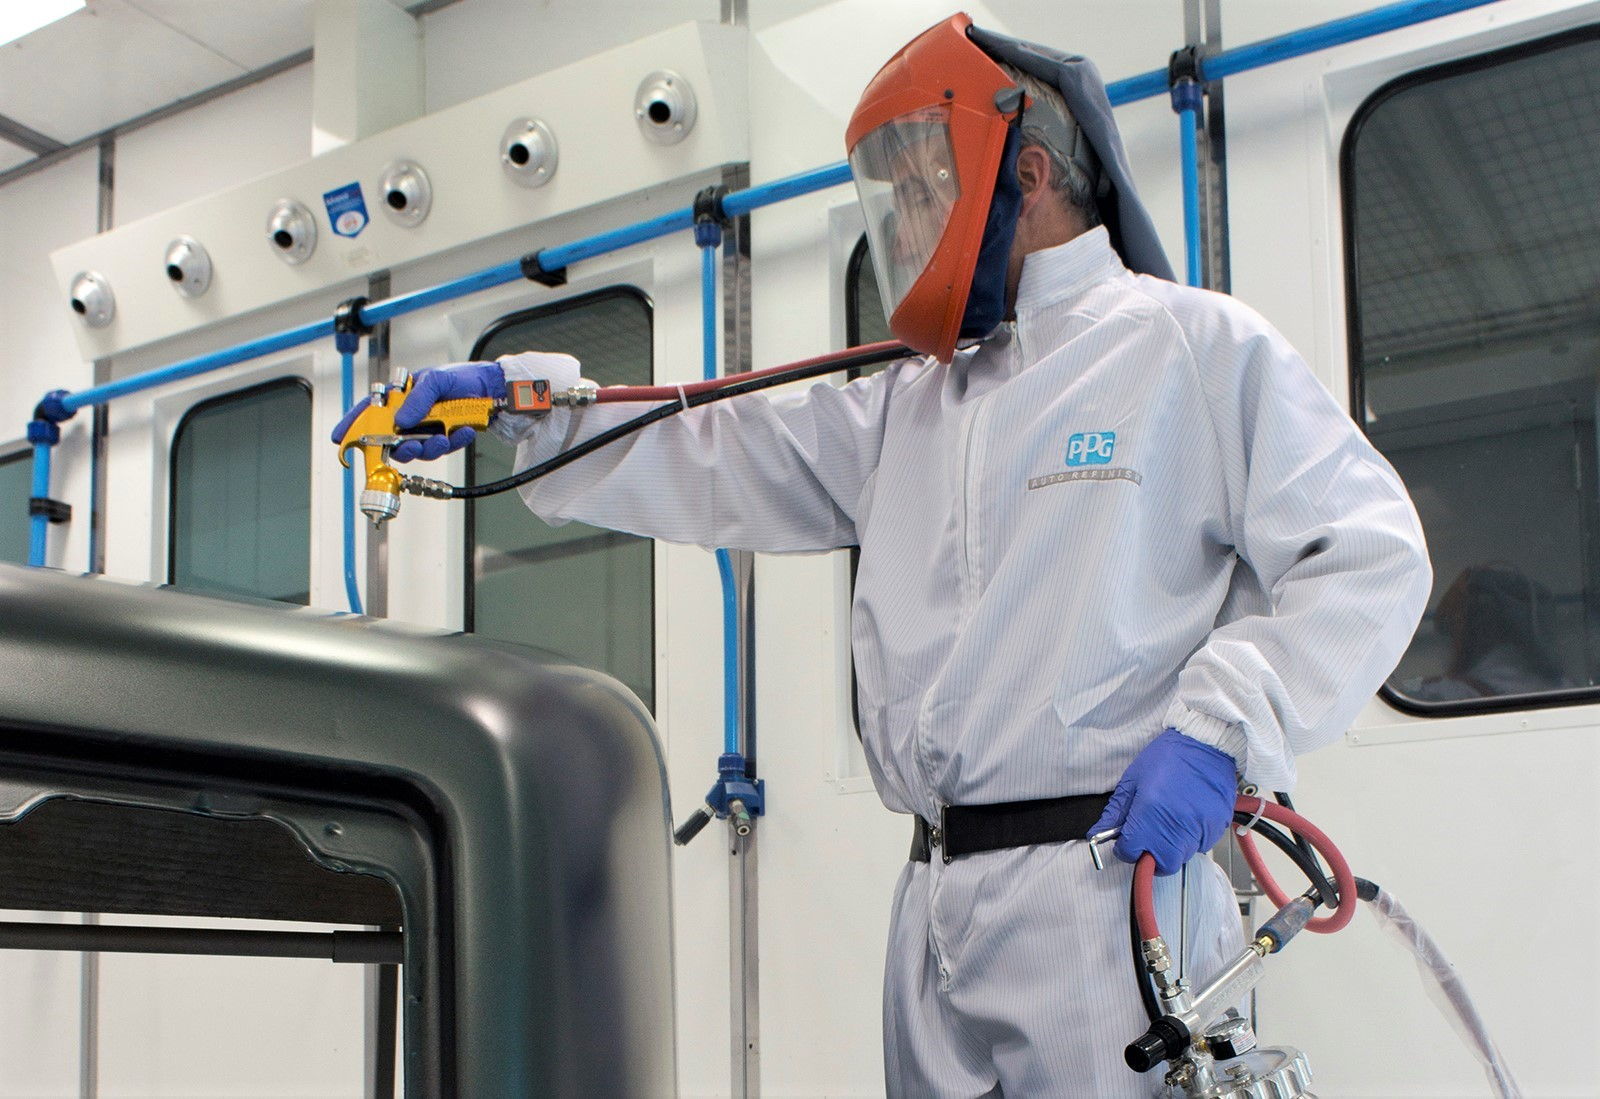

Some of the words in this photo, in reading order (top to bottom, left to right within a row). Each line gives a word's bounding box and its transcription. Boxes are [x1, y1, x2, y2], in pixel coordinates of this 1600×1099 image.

[1067, 433, 1114, 463] PPG
[1031, 474, 1064, 489] AUTO
[1071, 470, 1141, 482] REFINISH
